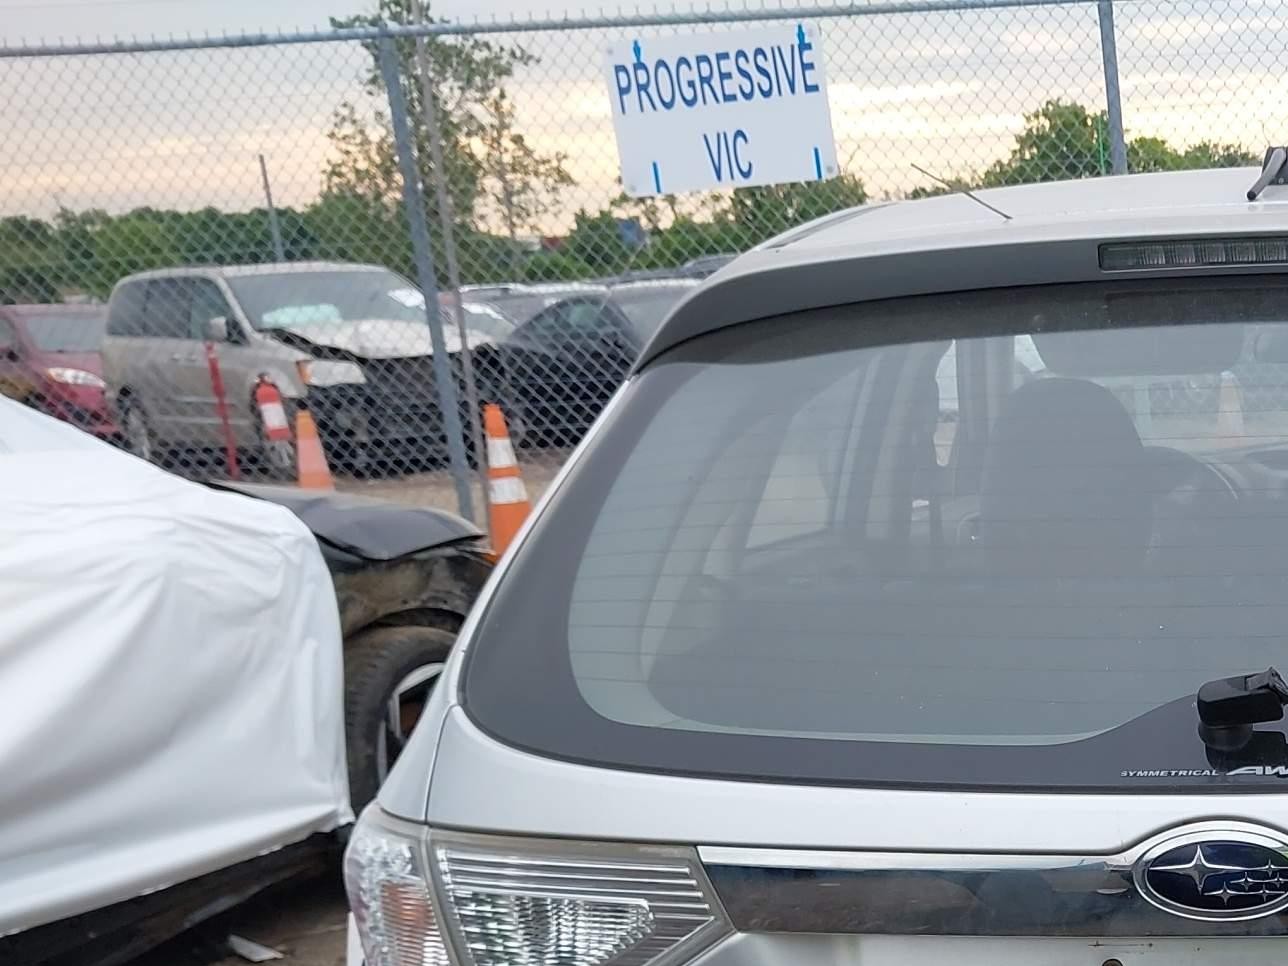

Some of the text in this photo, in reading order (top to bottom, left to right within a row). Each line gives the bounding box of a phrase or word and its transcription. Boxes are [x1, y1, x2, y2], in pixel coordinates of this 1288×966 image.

[614, 42, 820, 115] PROGRESSIVE
[703, 129, 753, 182] VIC
[1120, 769, 1220, 777] SYMMETRICAL
